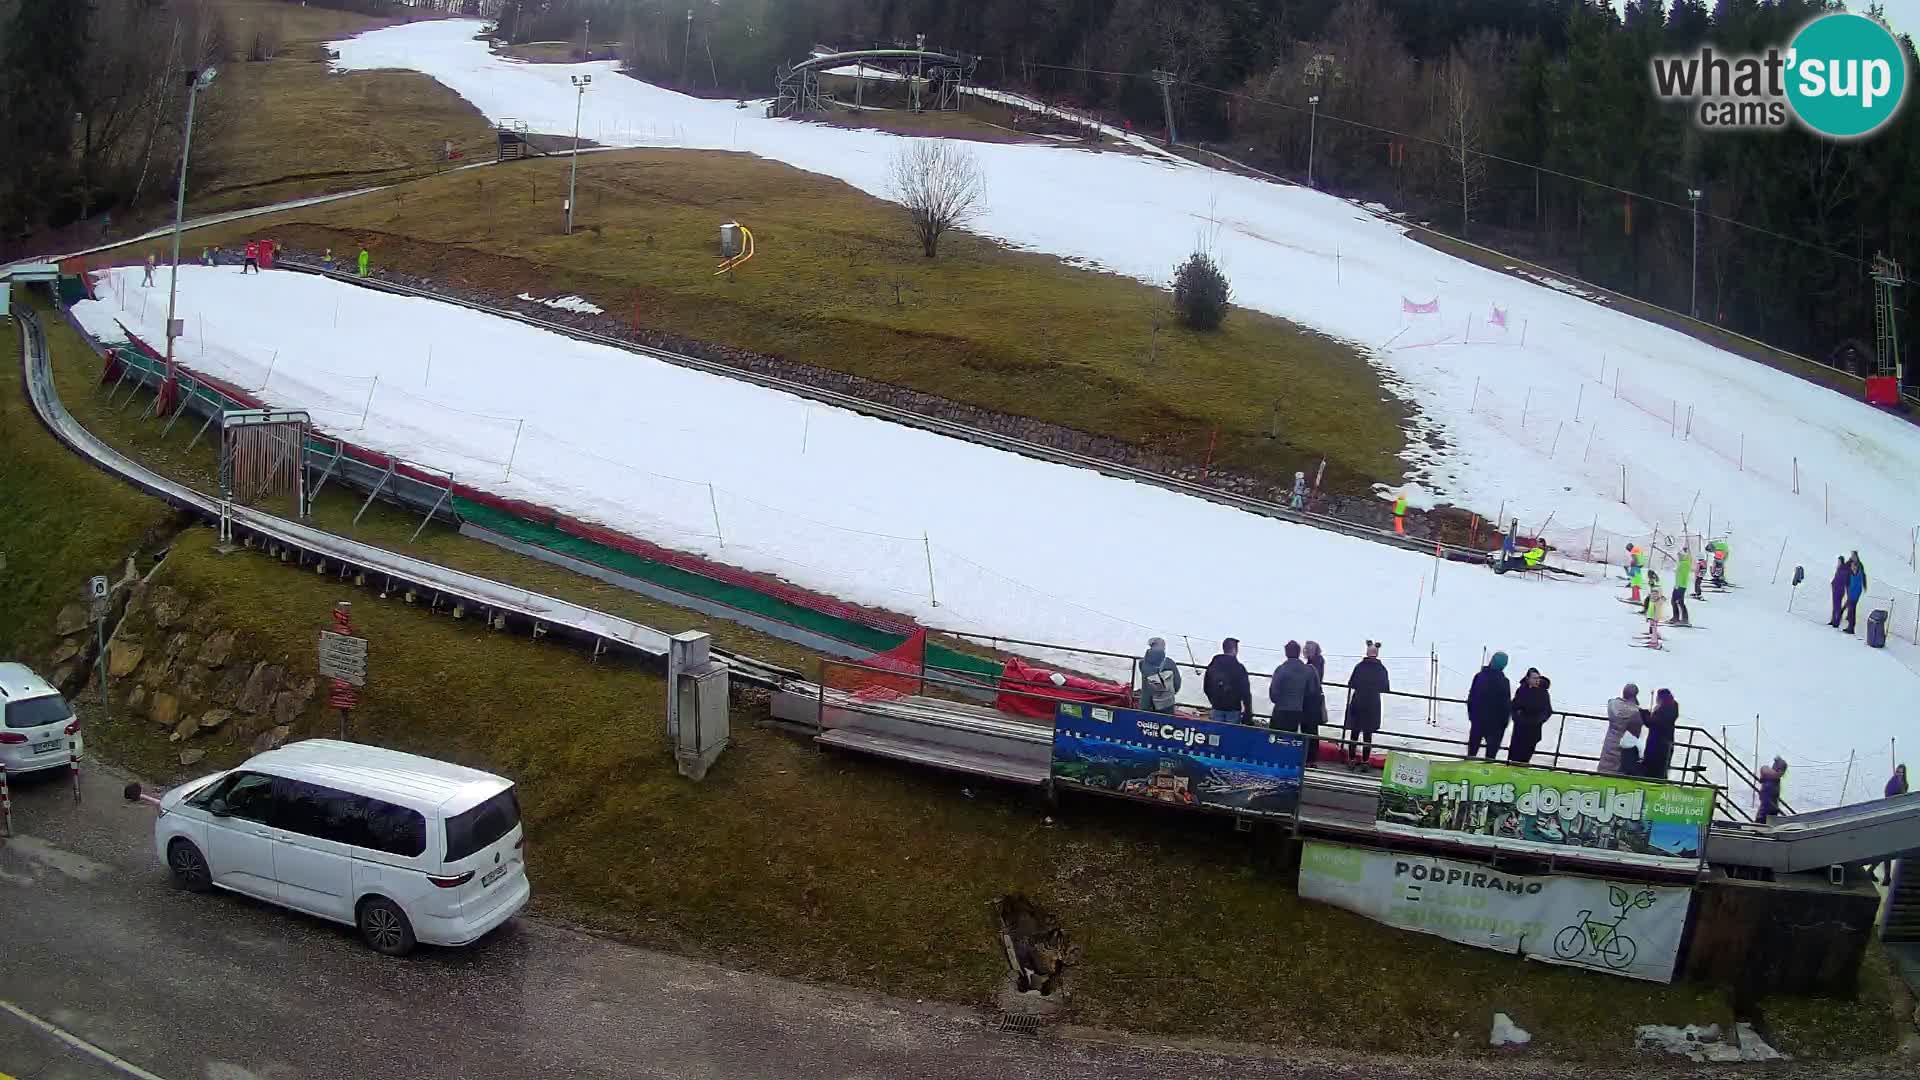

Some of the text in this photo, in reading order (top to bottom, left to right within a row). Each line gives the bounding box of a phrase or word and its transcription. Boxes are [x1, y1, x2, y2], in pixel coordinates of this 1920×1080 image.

[1161, 724, 1206, 747] Celje
[1473, 783, 1515, 804] nas
[1394, 861, 1543, 895] PODPIRAMO
